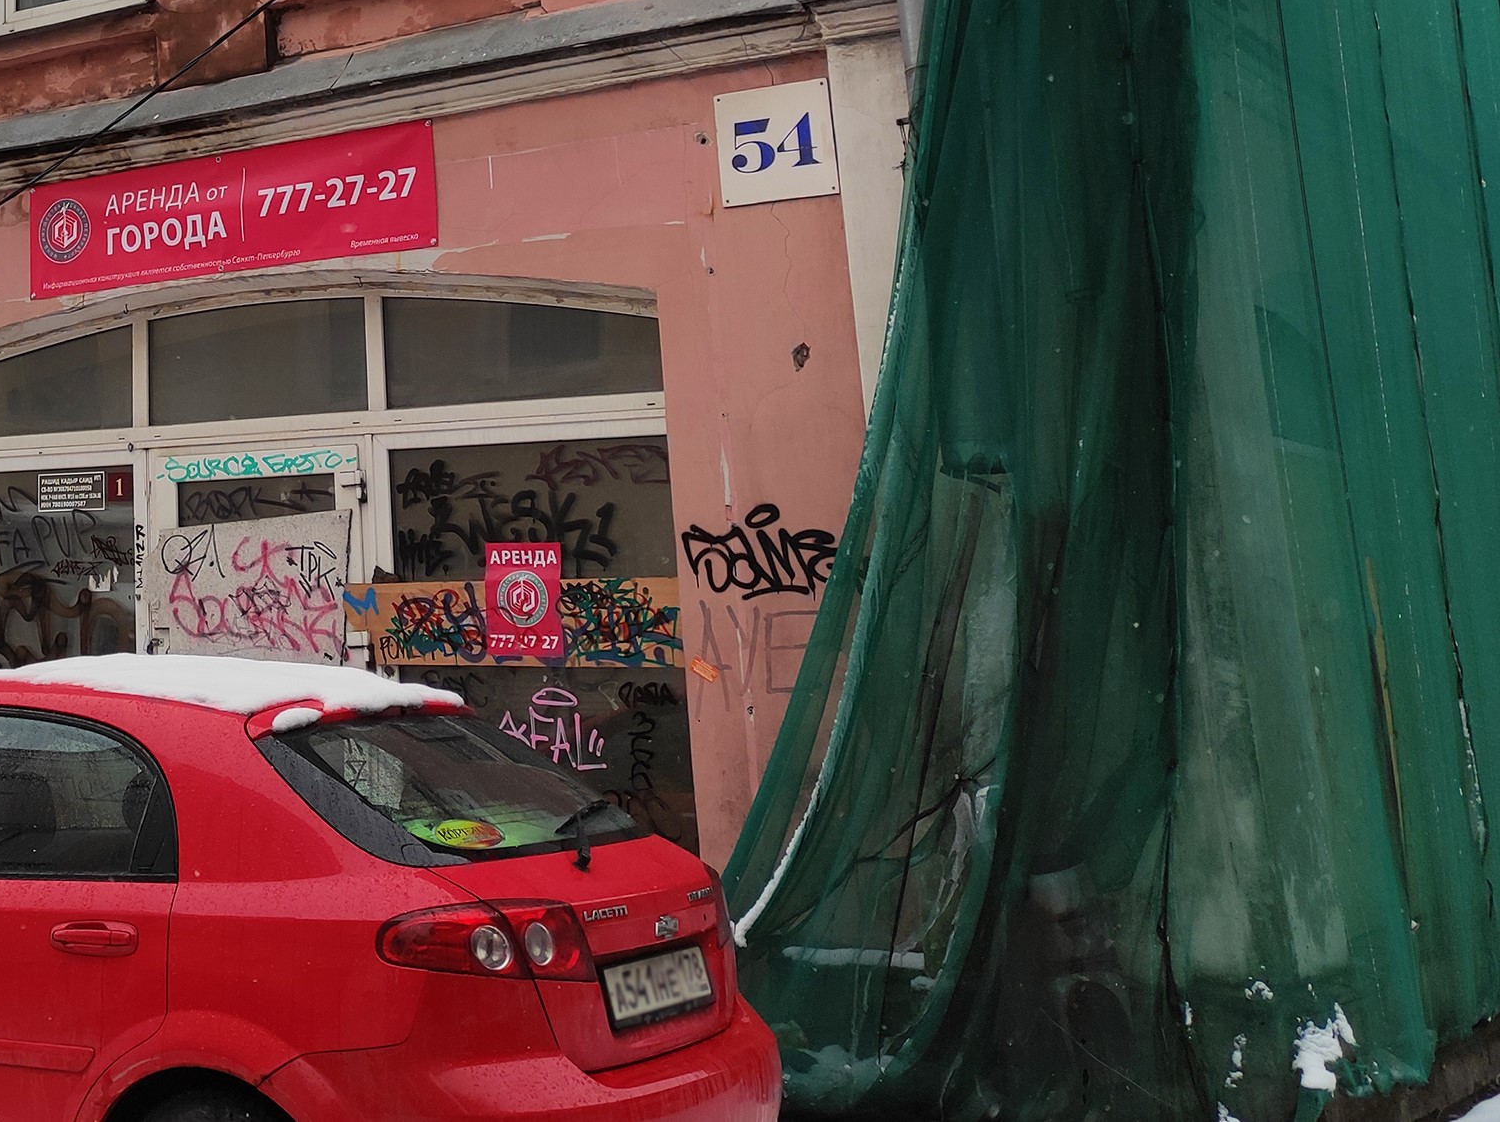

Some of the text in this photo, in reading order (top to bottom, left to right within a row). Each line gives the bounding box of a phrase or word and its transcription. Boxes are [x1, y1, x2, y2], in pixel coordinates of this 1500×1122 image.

[731, 111, 823, 174] 54
[105, 181, 228, 216] АРЕНДА от
[257, 166, 417, 218] 777-27-27
[105, 211, 228, 255] ГОРОДА
[115, 477, 124, 497] 1
[490, 550, 557, 568] АРЕНДА
[489, 634, 515, 648] 777
[541, 635, 559, 649] 27
[582, 904, 628, 922] LACETTI
